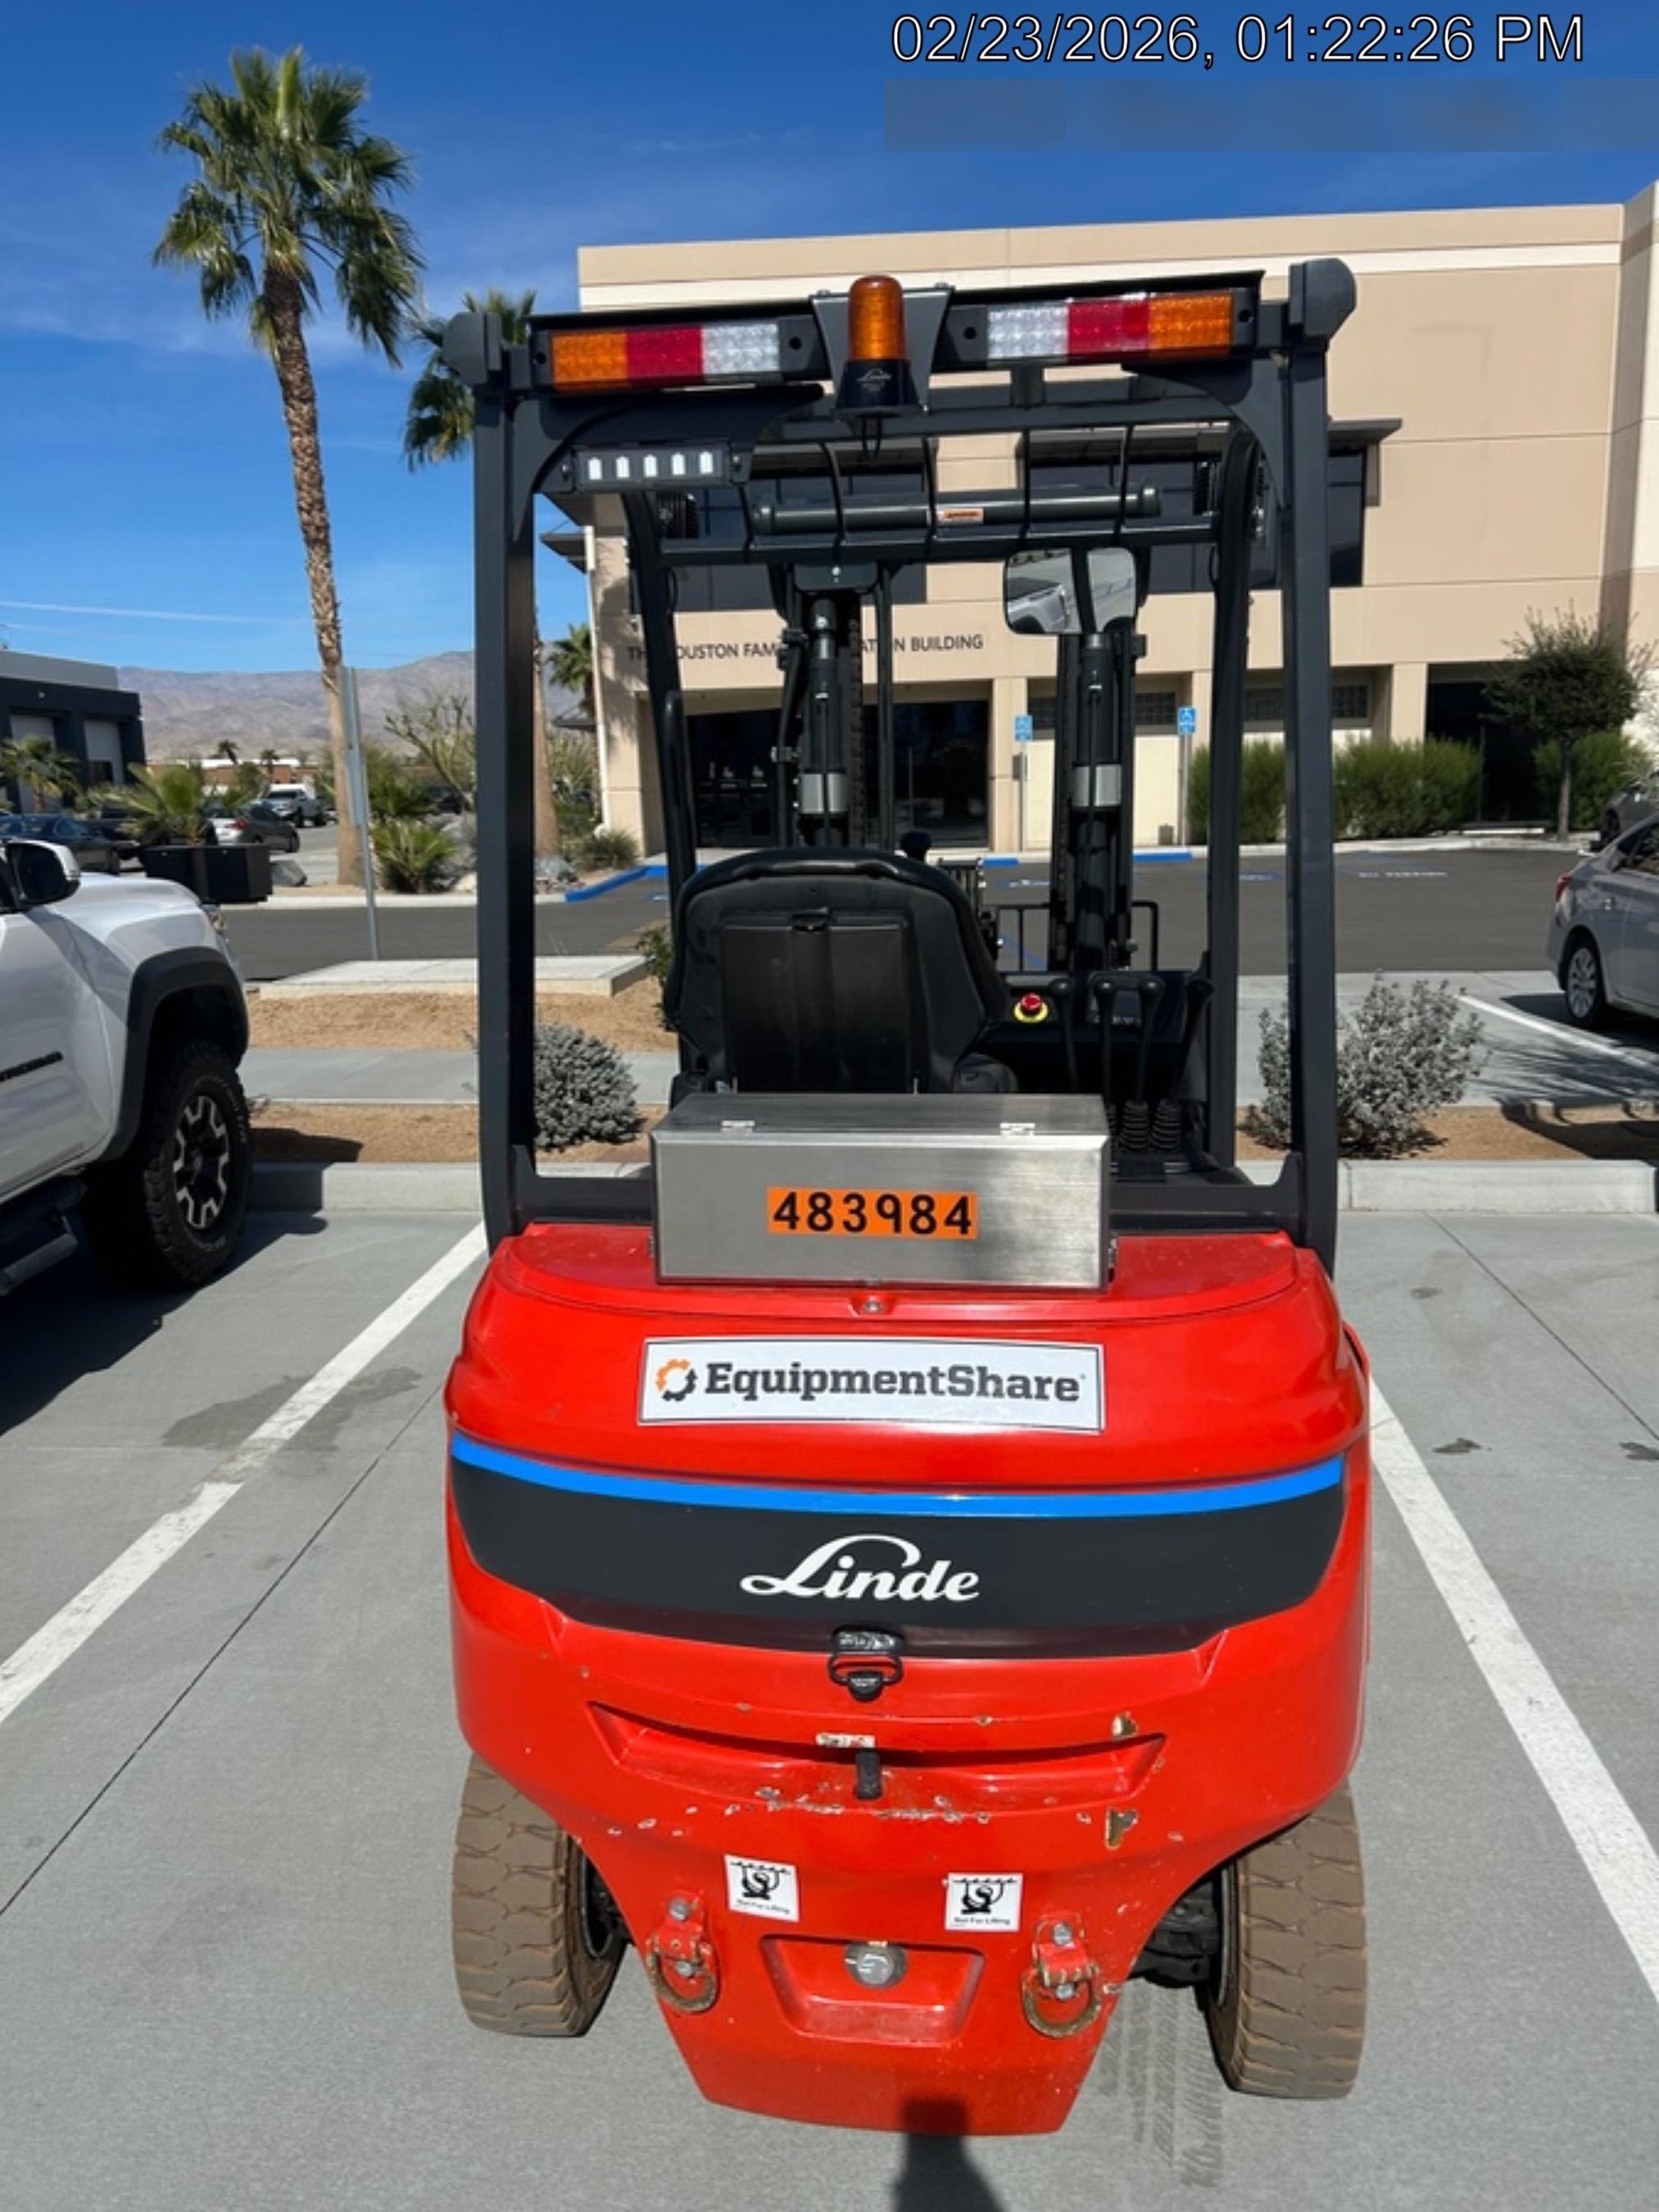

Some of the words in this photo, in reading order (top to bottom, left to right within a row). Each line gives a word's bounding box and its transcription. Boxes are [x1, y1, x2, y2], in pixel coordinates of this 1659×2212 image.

[628, 646, 646, 661] TH
[676, 643, 739, 660] OUSTON
[911, 634, 984, 652] BUILDING
[773, 1191, 972, 1235] 483984
[705, 1362, 1080, 1402] EquipmentShare
[740, 1534, 980, 1602] Linde
